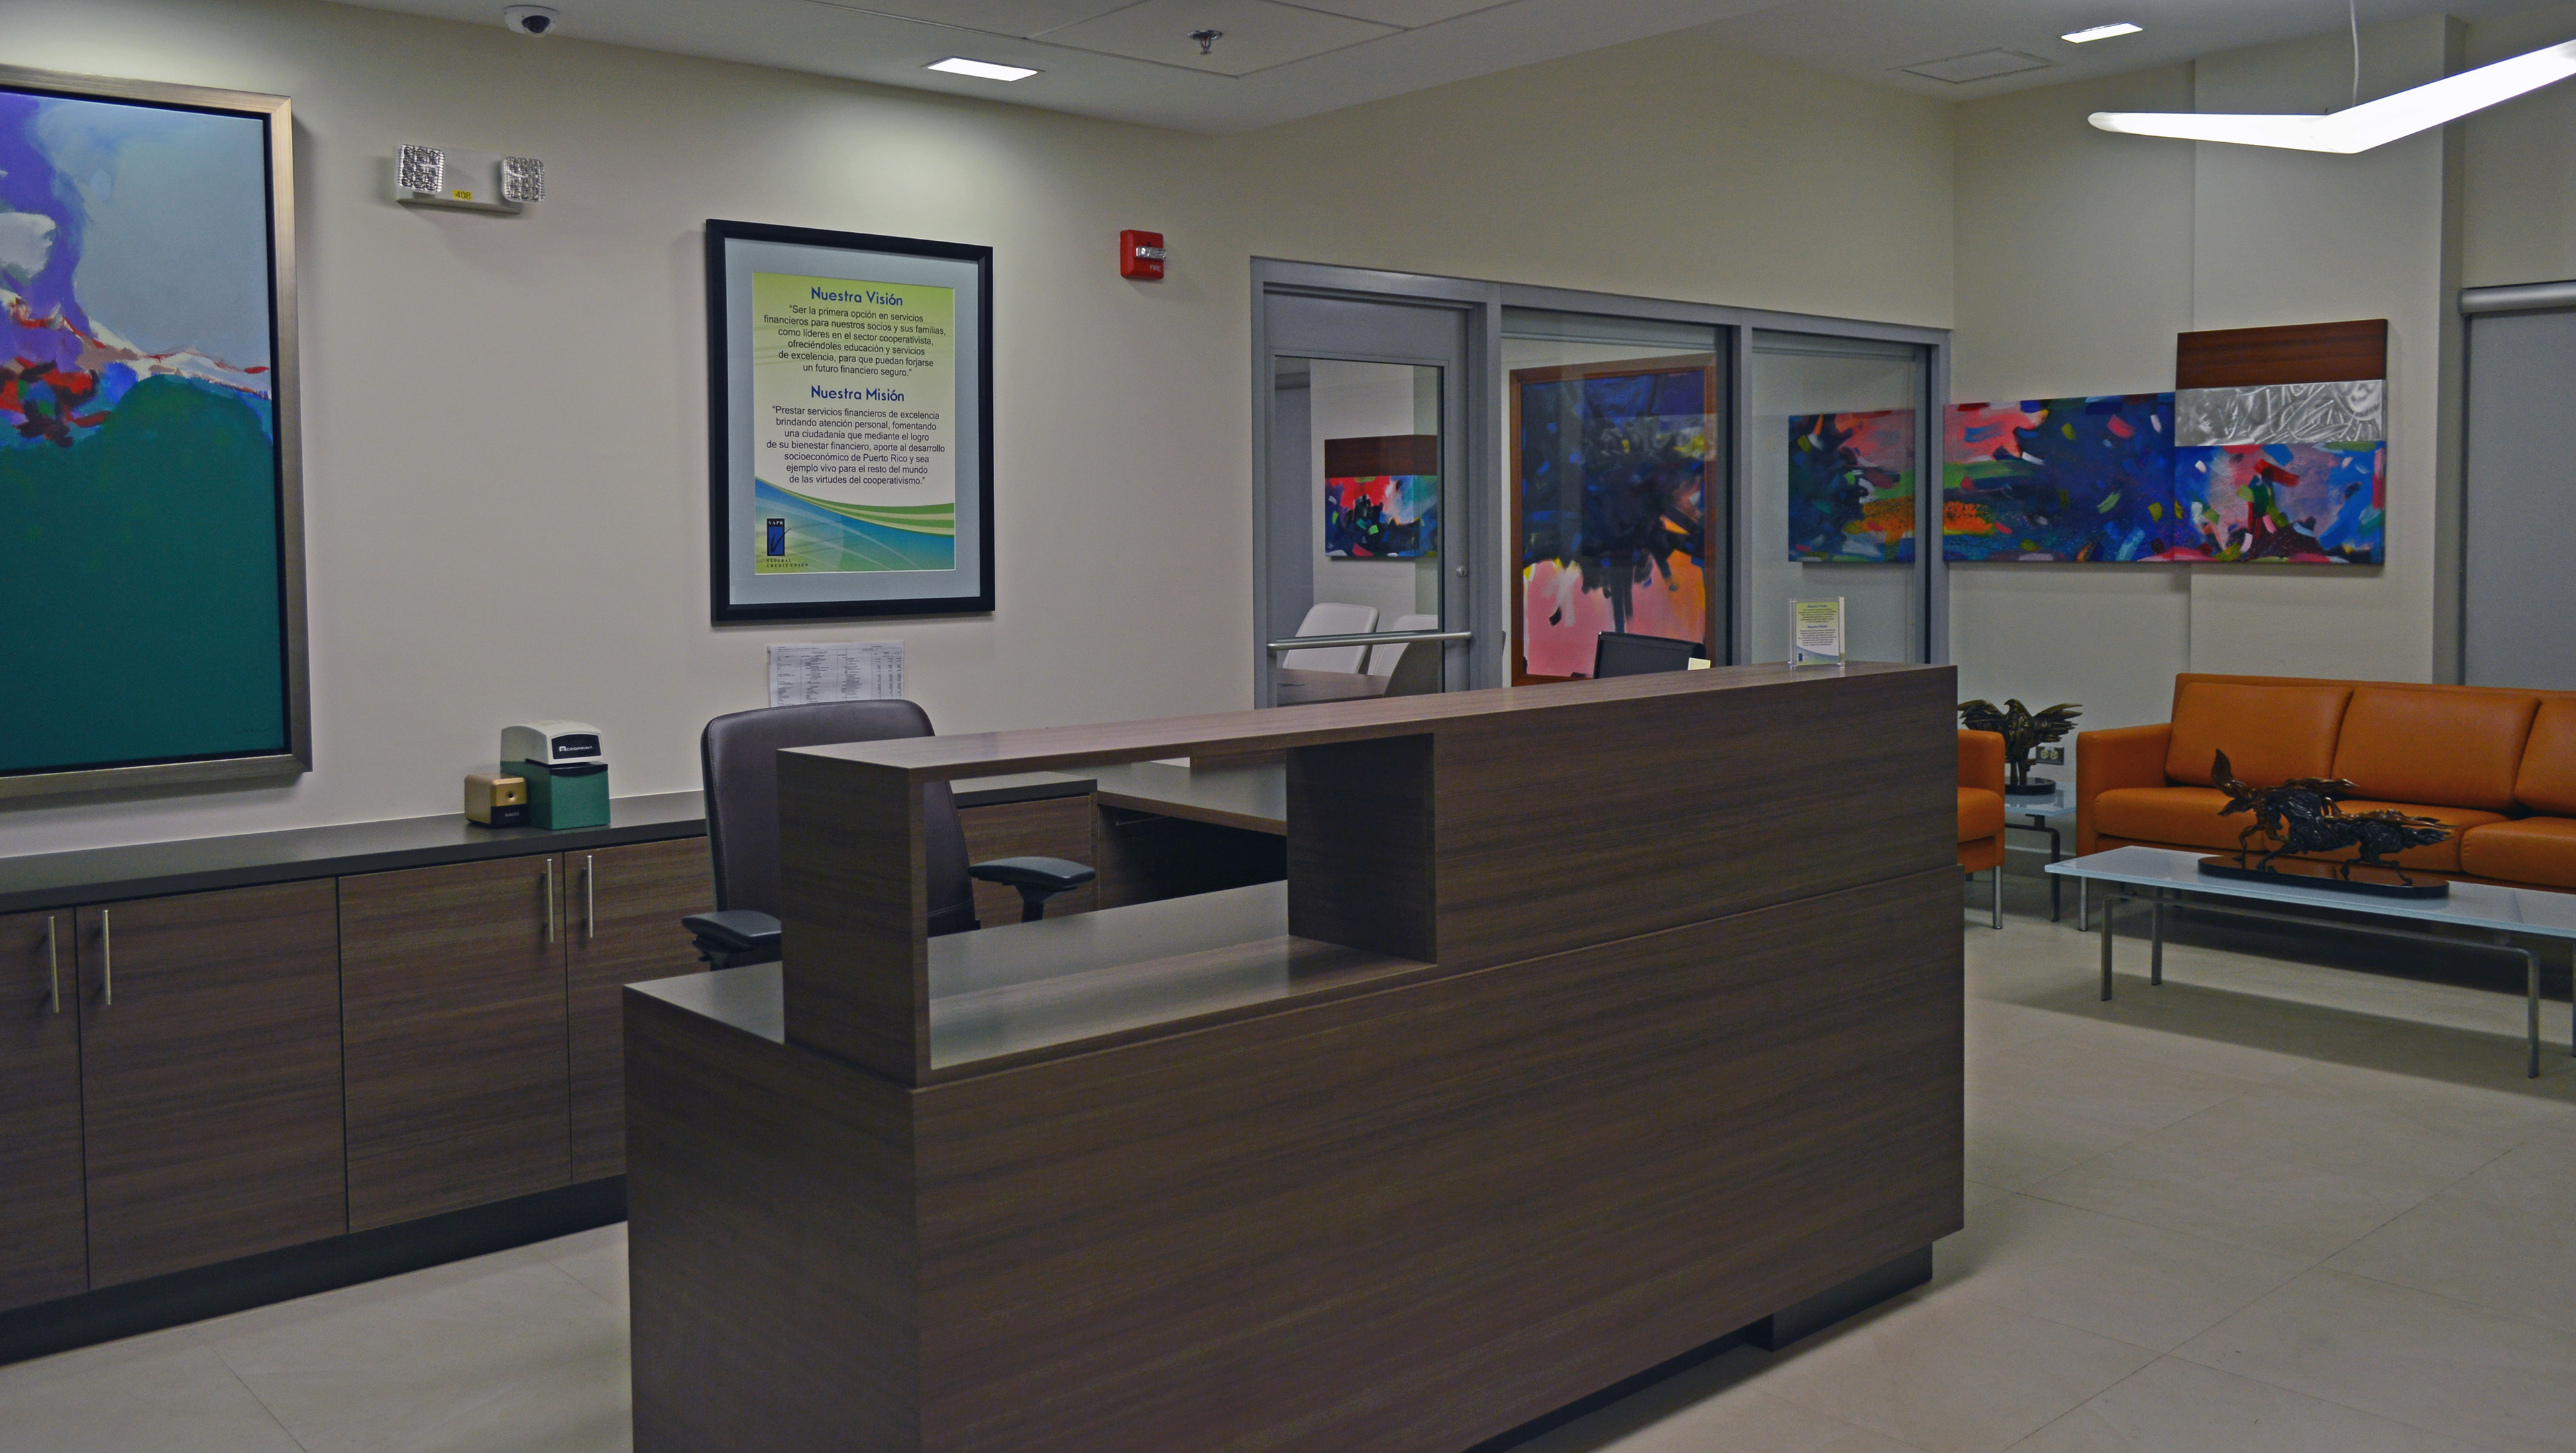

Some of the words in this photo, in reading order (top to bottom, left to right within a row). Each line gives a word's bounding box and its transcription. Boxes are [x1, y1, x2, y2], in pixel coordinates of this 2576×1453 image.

[455, 191, 471, 200] 408
[811, 287, 861, 303] Nuestra
[866, 291, 903, 306] Visión
[809, 307, 816, 315] la
[818, 307, 848, 317] primera
[851, 310, 876, 319] opción
[891, 313, 923, 322] servicios
[764, 315, 808, 326] financieros
[811, 319, 829, 327] para
[832, 321, 865, 329] nuestros
[867, 323, 891, 331] socios
[916, 325, 946, 335] familias,
[778, 329, 800, 337] como
[803, 329, 829, 338] líderes
[853, 333, 877, 341] sector
[879, 334, 934, 345] cooperativista,
[788, 340, 841, 350] ofreciéndoles
[844, 343, 883, 353] educación
[892, 346, 924, 355] servicios
[792, 352, 836, 362] excelencia,
[839, 356, 856, 365] para
[875, 357, 903, 366] puedan
[906, 358, 933, 368] forjarse
[816, 364, 838, 372] futuro
[841, 365, 878, 374] financiero
[811, 385, 861, 400] Nuestra
[866, 388, 904, 401] Misión
[808, 408, 842, 416] servicios
[845, 408, 886, 417] financieros
[900, 411, 939, 419] excelencia
[776, 417, 816, 427] brindando
[819, 419, 853, 428] atención
[855, 421, 890, 429] personal,
[892, 421, 936, 430] fomentando
[802, 429, 845, 439] ciudadanía
[848, 432, 862, 440] que
[865, 431, 900, 440] mediante
[910, 433, 929, 441] logro
[792, 441, 828, 449] bienestar
[830, 442, 871, 452] financiero,
[873, 443, 898, 452] aporte
[908, 444, 945, 452] desarrollo
[784, 452, 849, 462] socioeconómico
[851, 453, 861, 462] de
[863, 453, 888, 462] Puerto
[786, 464, 818, 474] ejemplo
[839, 466, 856, 474] para
[902, 466, 928, 474] mundo
[790, 475, 800, 483] de
[802, 475, 813, 483] las
[816, 476, 847, 484] virtudes
